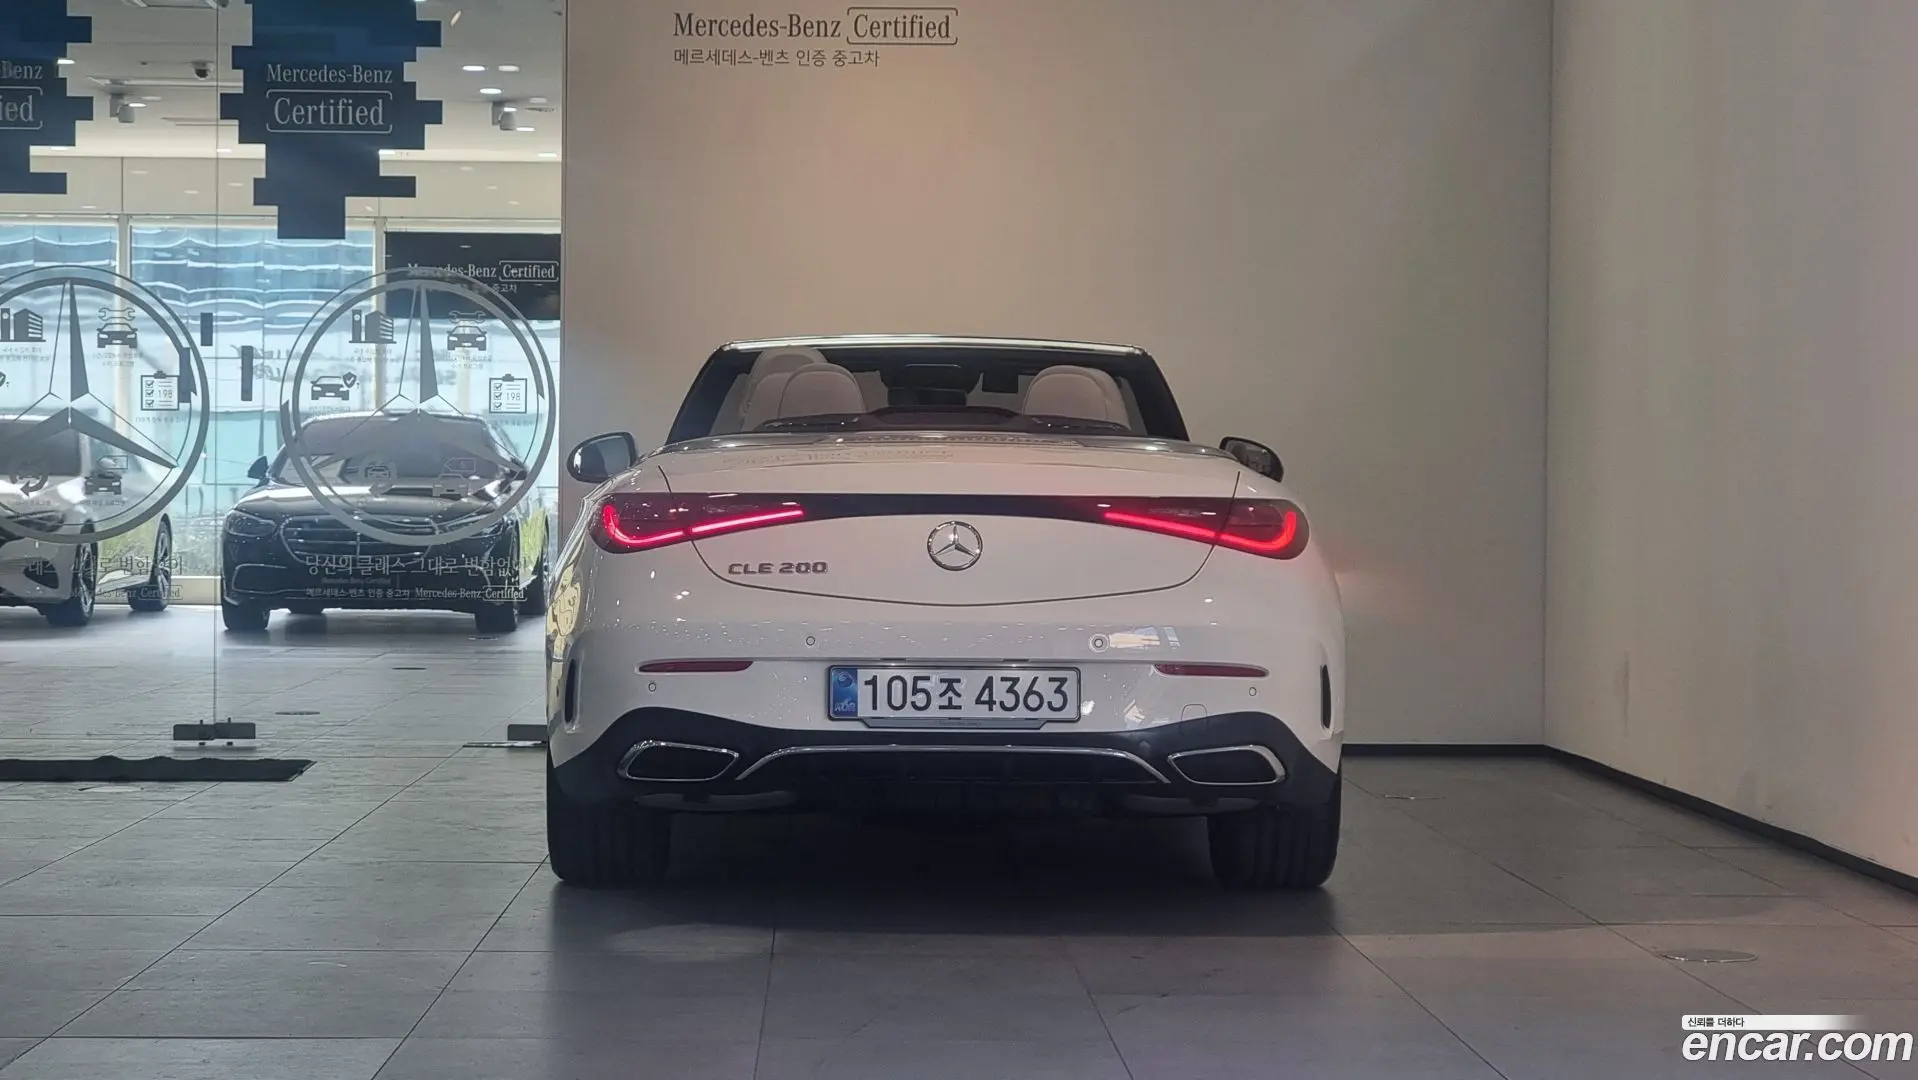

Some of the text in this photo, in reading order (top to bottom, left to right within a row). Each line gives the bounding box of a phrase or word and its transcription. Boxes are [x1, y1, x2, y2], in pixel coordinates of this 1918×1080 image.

[673, 12, 951, 39] Mercedes-Benz Certified
[673, 48, 880, 67] 메르세데스-벤츠 인증 중고차
[266, 64, 393, 84] Mercedes-Benz
[273, 98, 385, 126] Certified
[502, 263, 556, 279] Certified
[158, 389, 173, 399] 198
[506, 392, 521, 401] 198
[305, 555, 353, 577] 당신의
[356, 555, 407, 577] 클래스
[410, 556, 460, 577] 그대로
[728, 561, 828, 575] CLE 200
[415, 586, 524, 600] Mercedes-Benz Certified
[863, 674, 1069, 713] 105조 4363
